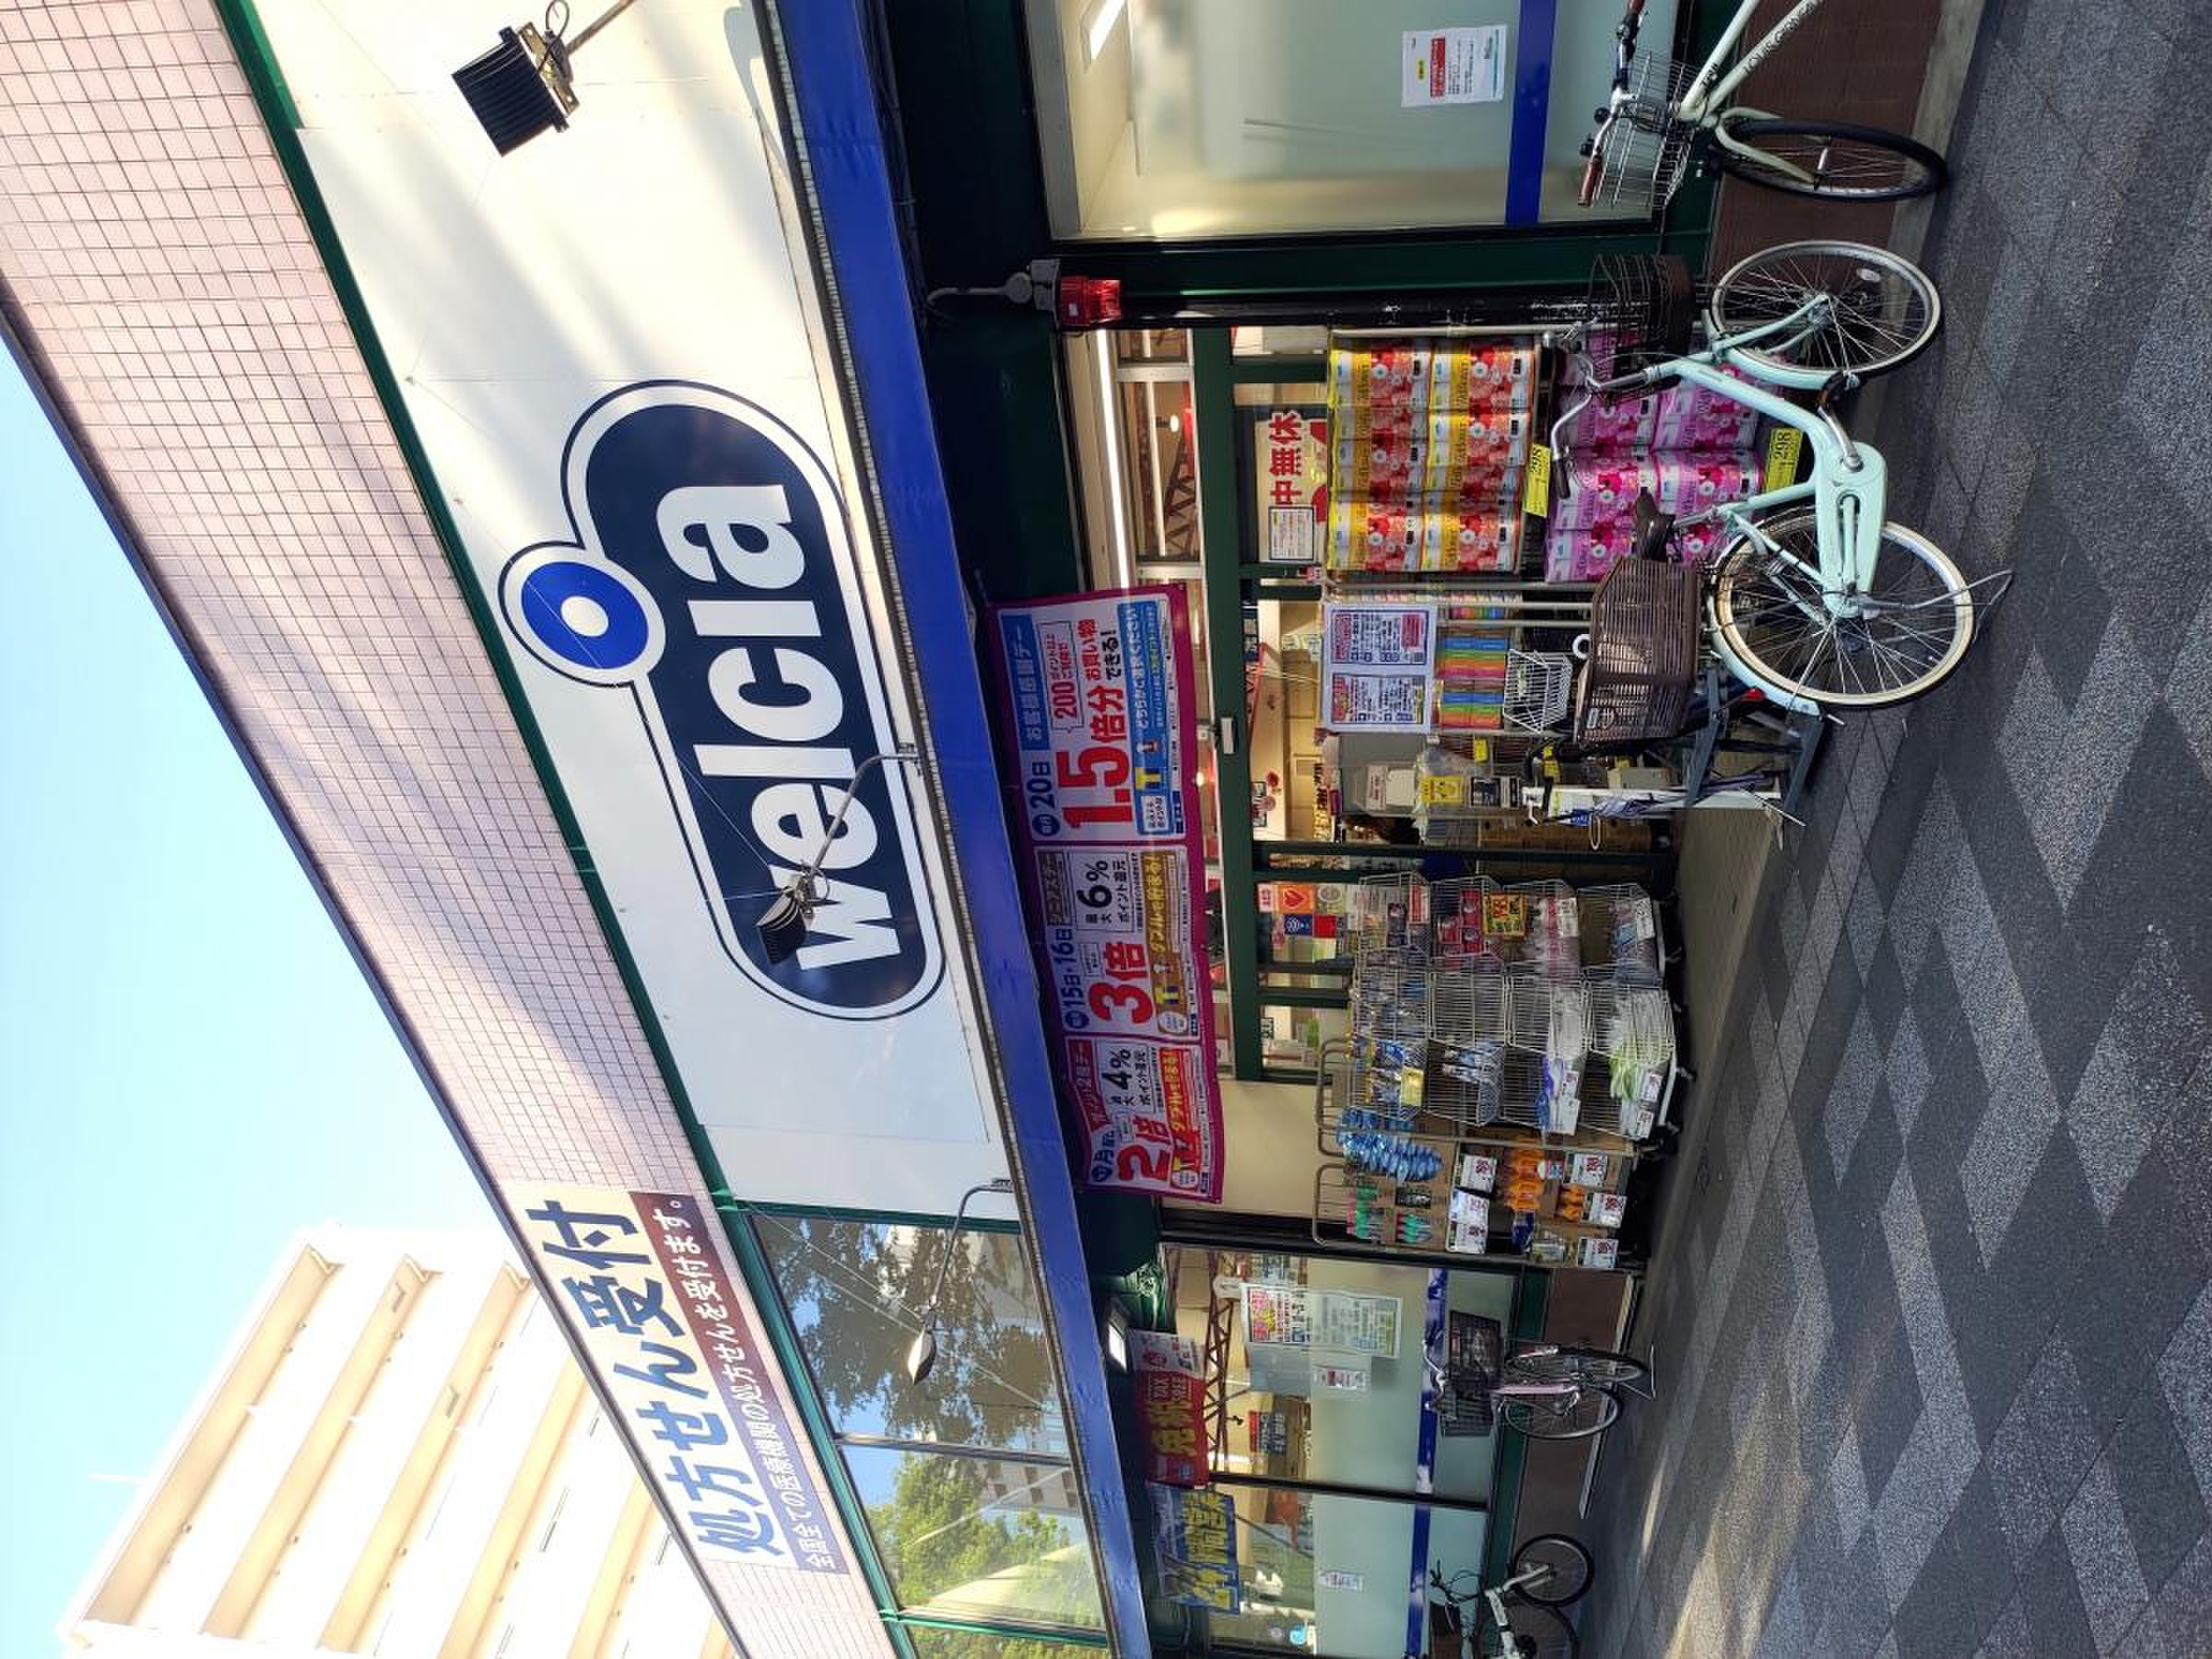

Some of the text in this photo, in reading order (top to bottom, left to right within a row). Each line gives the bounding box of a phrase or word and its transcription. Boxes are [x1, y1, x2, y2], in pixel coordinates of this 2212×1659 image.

[1772, 431, 1791, 458] 298
[1077, 618, 1101, 680] お買い物
[655, 483, 901, 970] welcia
[1052, 680, 1077, 718] 200
[1077, 860, 1112, 907] 6%
[1112, 859, 1129, 921] ポイント還元
[1088, 941, 1152, 1022] 3倍
[524, 1198, 784, 1555] 処方せん受付
[653, 1199, 836, 1568] 全国全ての医療機関の処方せんを受付ます。
[1152, 1377, 1169, 1397] TAX
